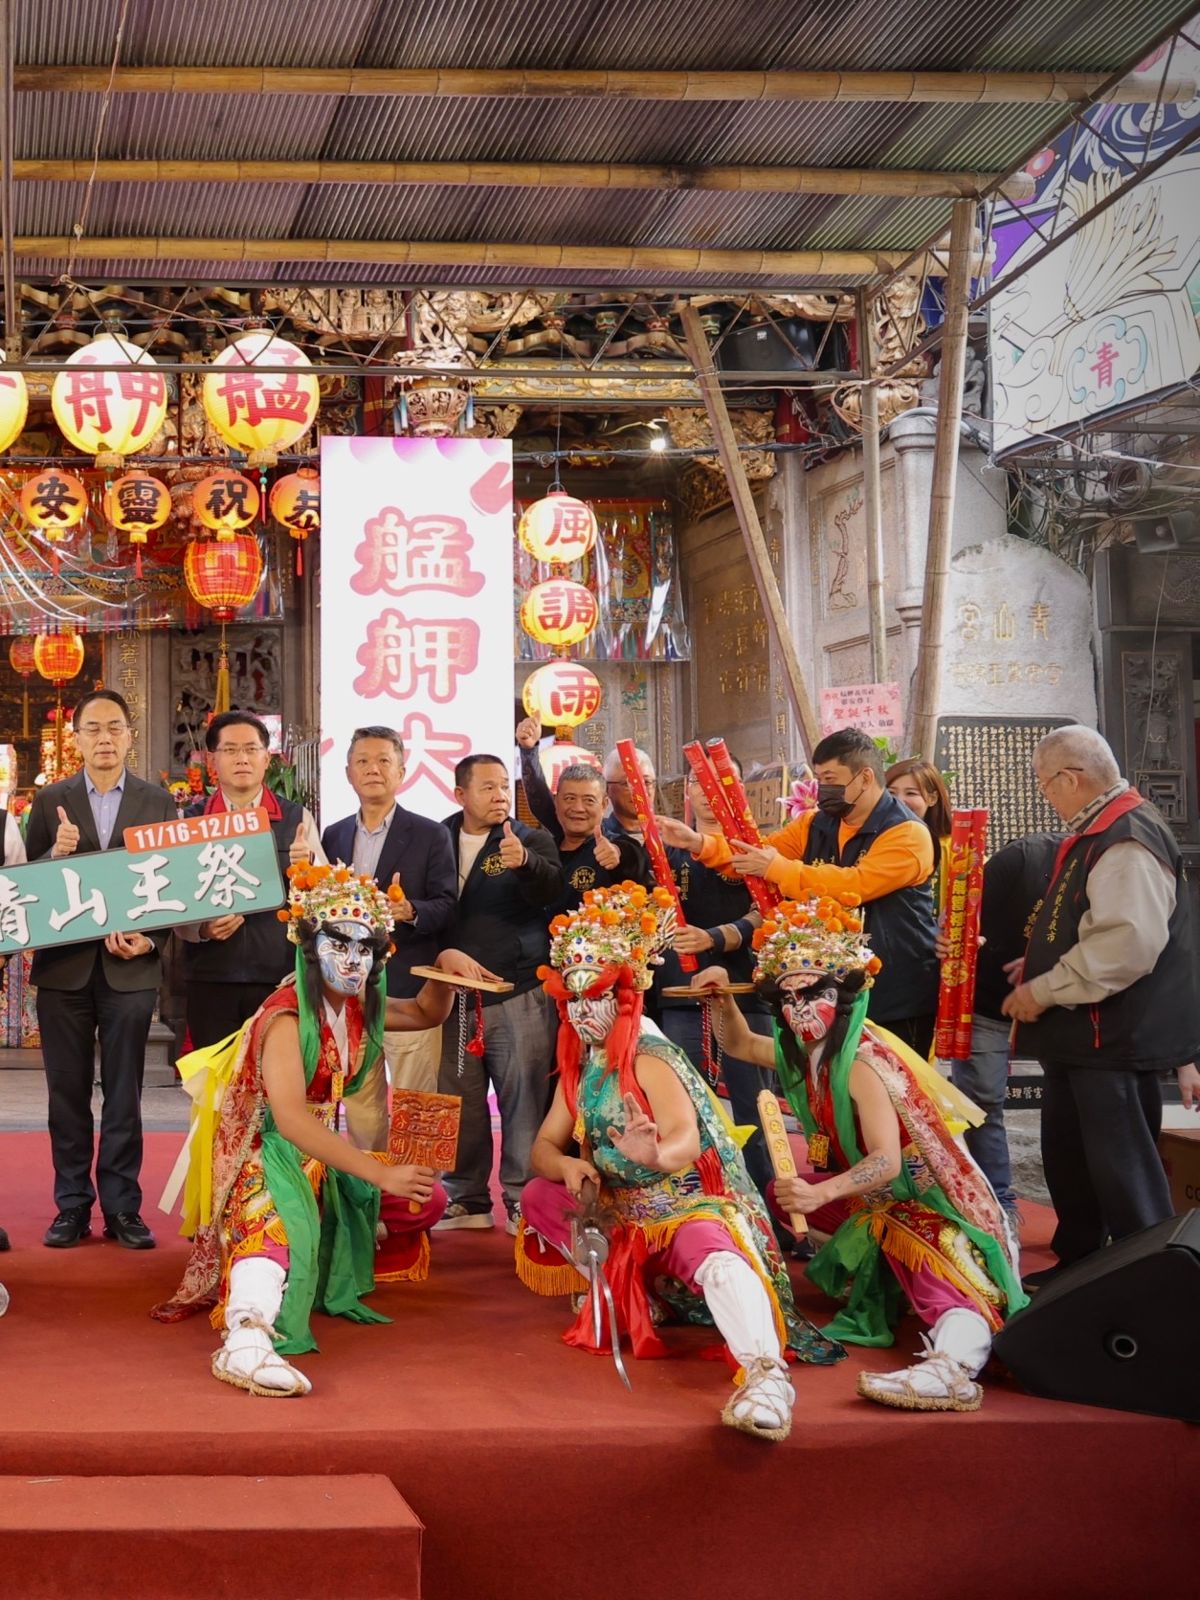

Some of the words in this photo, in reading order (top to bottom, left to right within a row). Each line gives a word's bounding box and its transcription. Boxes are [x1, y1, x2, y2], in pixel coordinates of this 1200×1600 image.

[1090, 341, 1120, 390] 青
[30, 476, 80, 520] 安
[116, 479, 162, 525] 靈
[205, 479, 253, 520] 祝
[544, 501, 594, 549] 風
[537, 586, 597, 632] 調
[550, 670, 600, 718] 雨
[133, 811, 261, 850] 11/16-12/05
